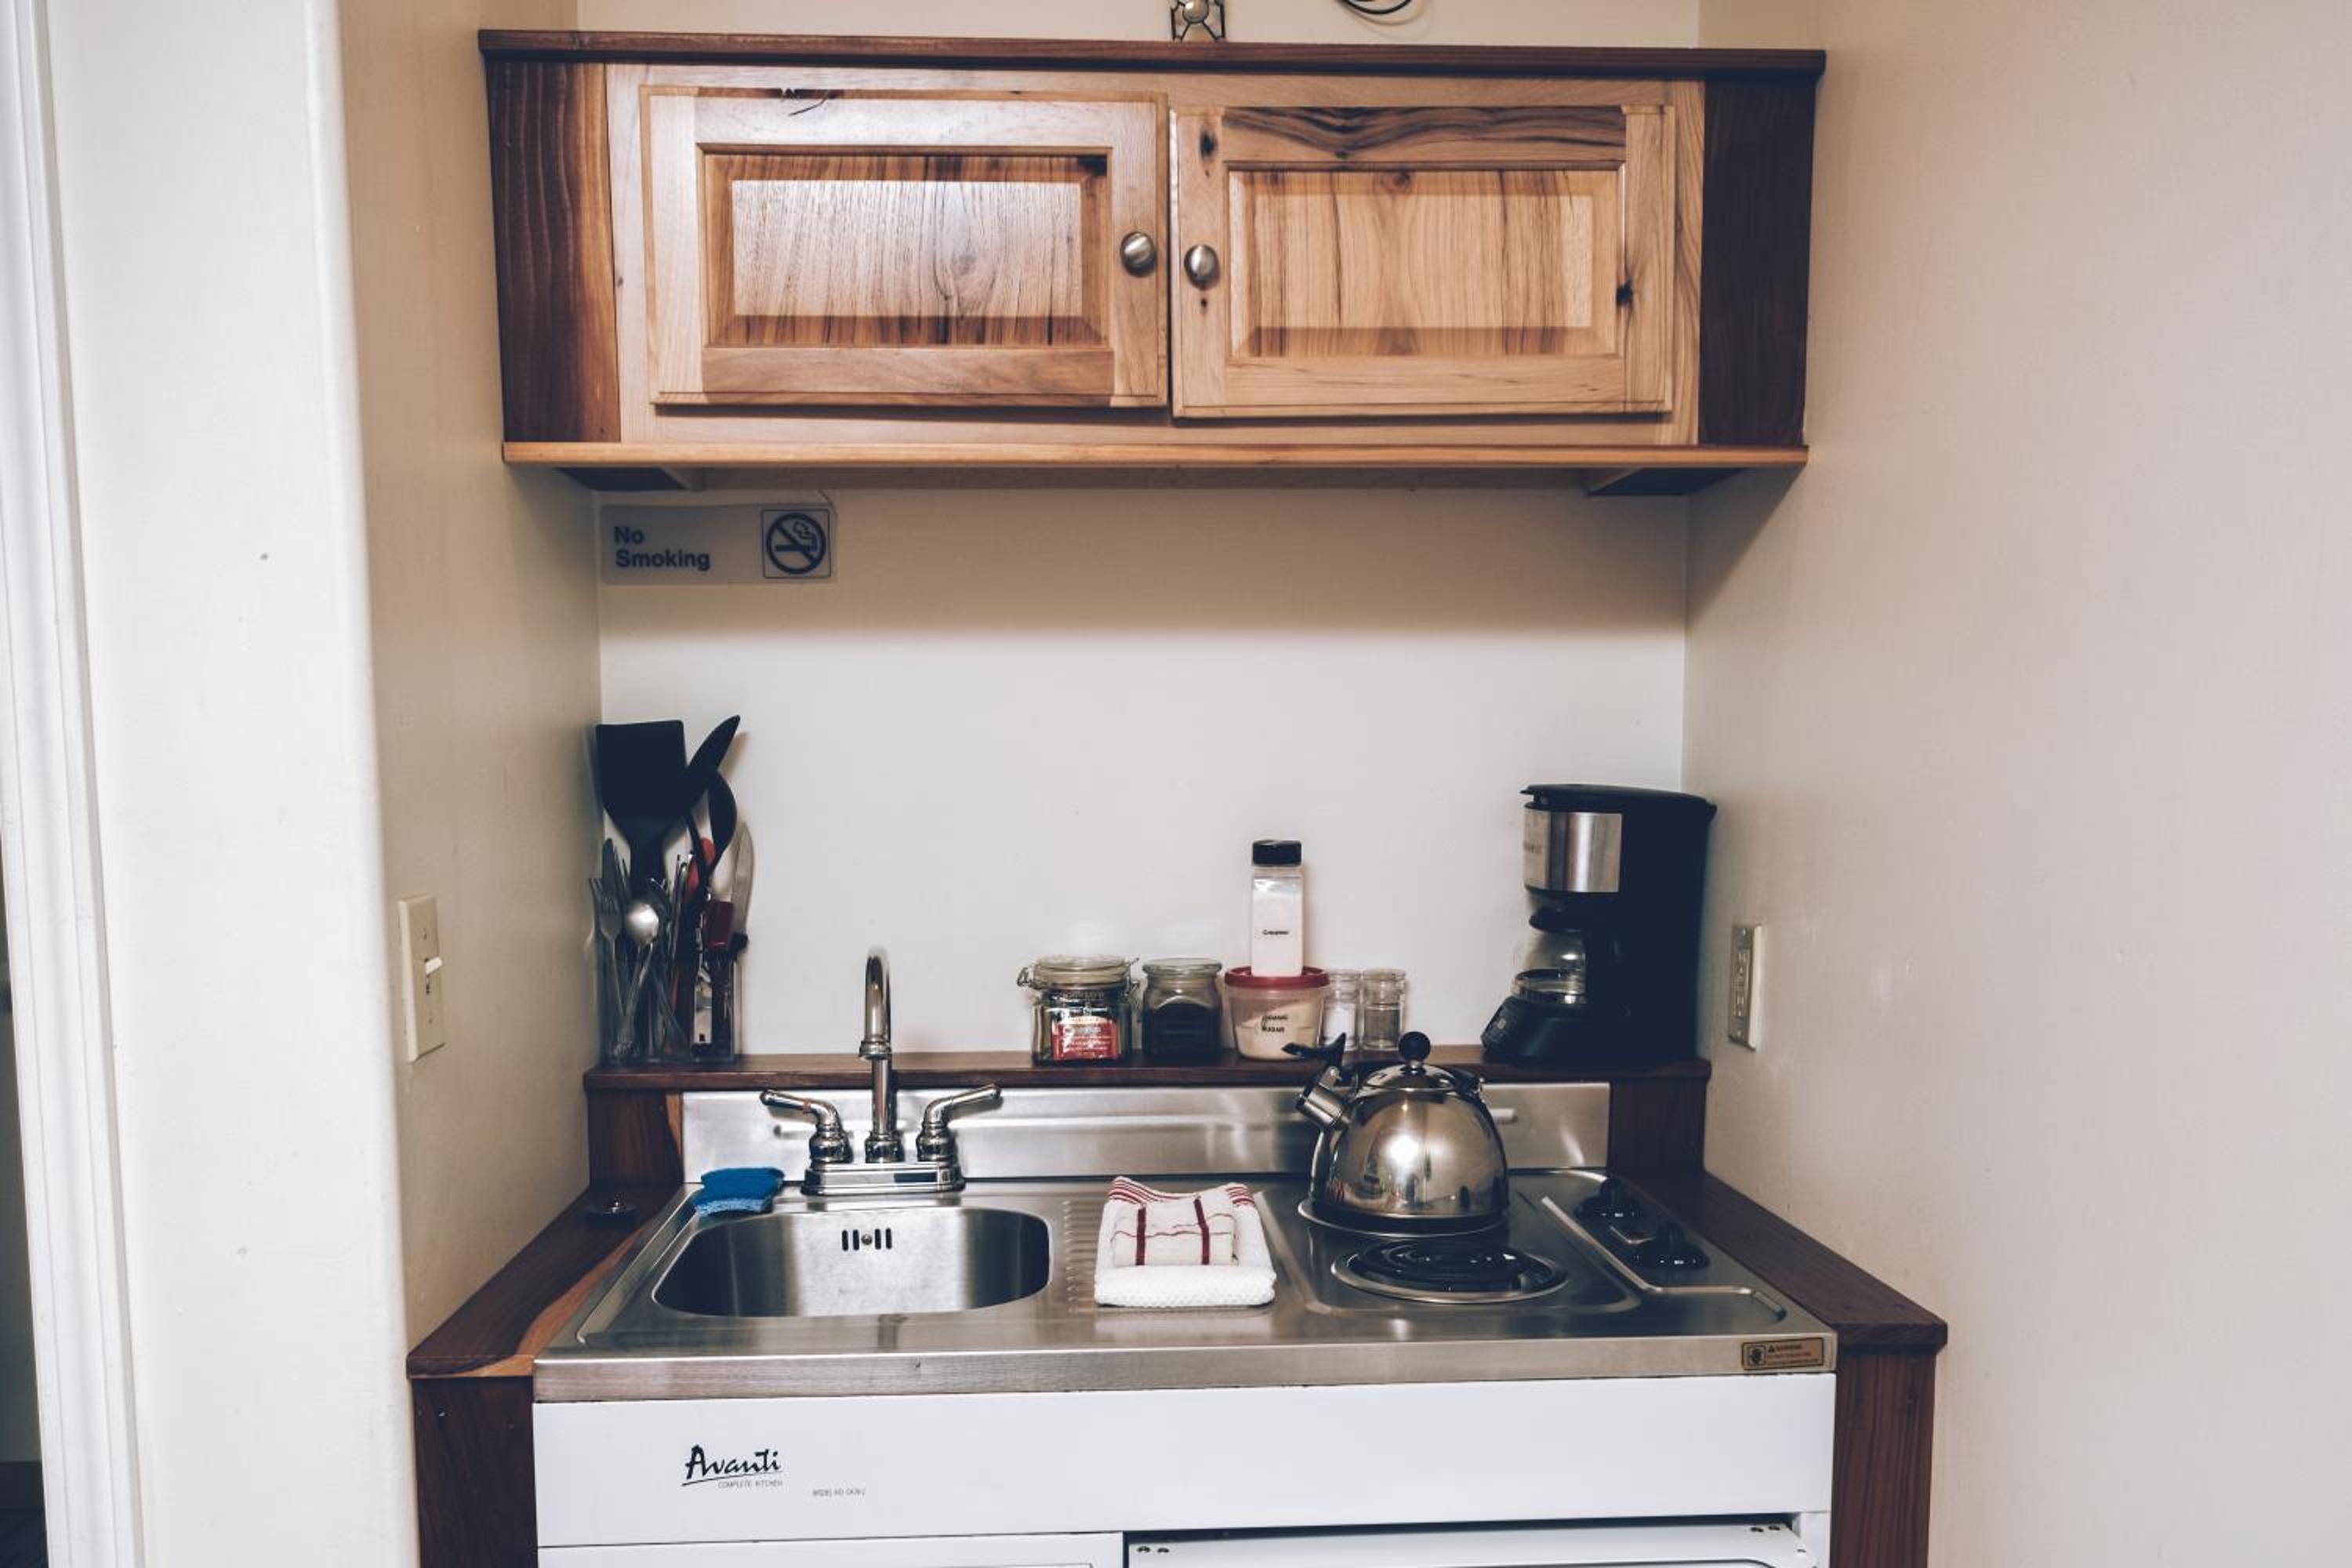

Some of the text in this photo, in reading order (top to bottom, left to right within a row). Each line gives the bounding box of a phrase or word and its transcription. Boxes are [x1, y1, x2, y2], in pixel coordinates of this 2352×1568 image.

[614, 526, 645, 544] No
[615, 550, 711, 571] Smoking
[685, 1444, 781, 1480] Avanti
